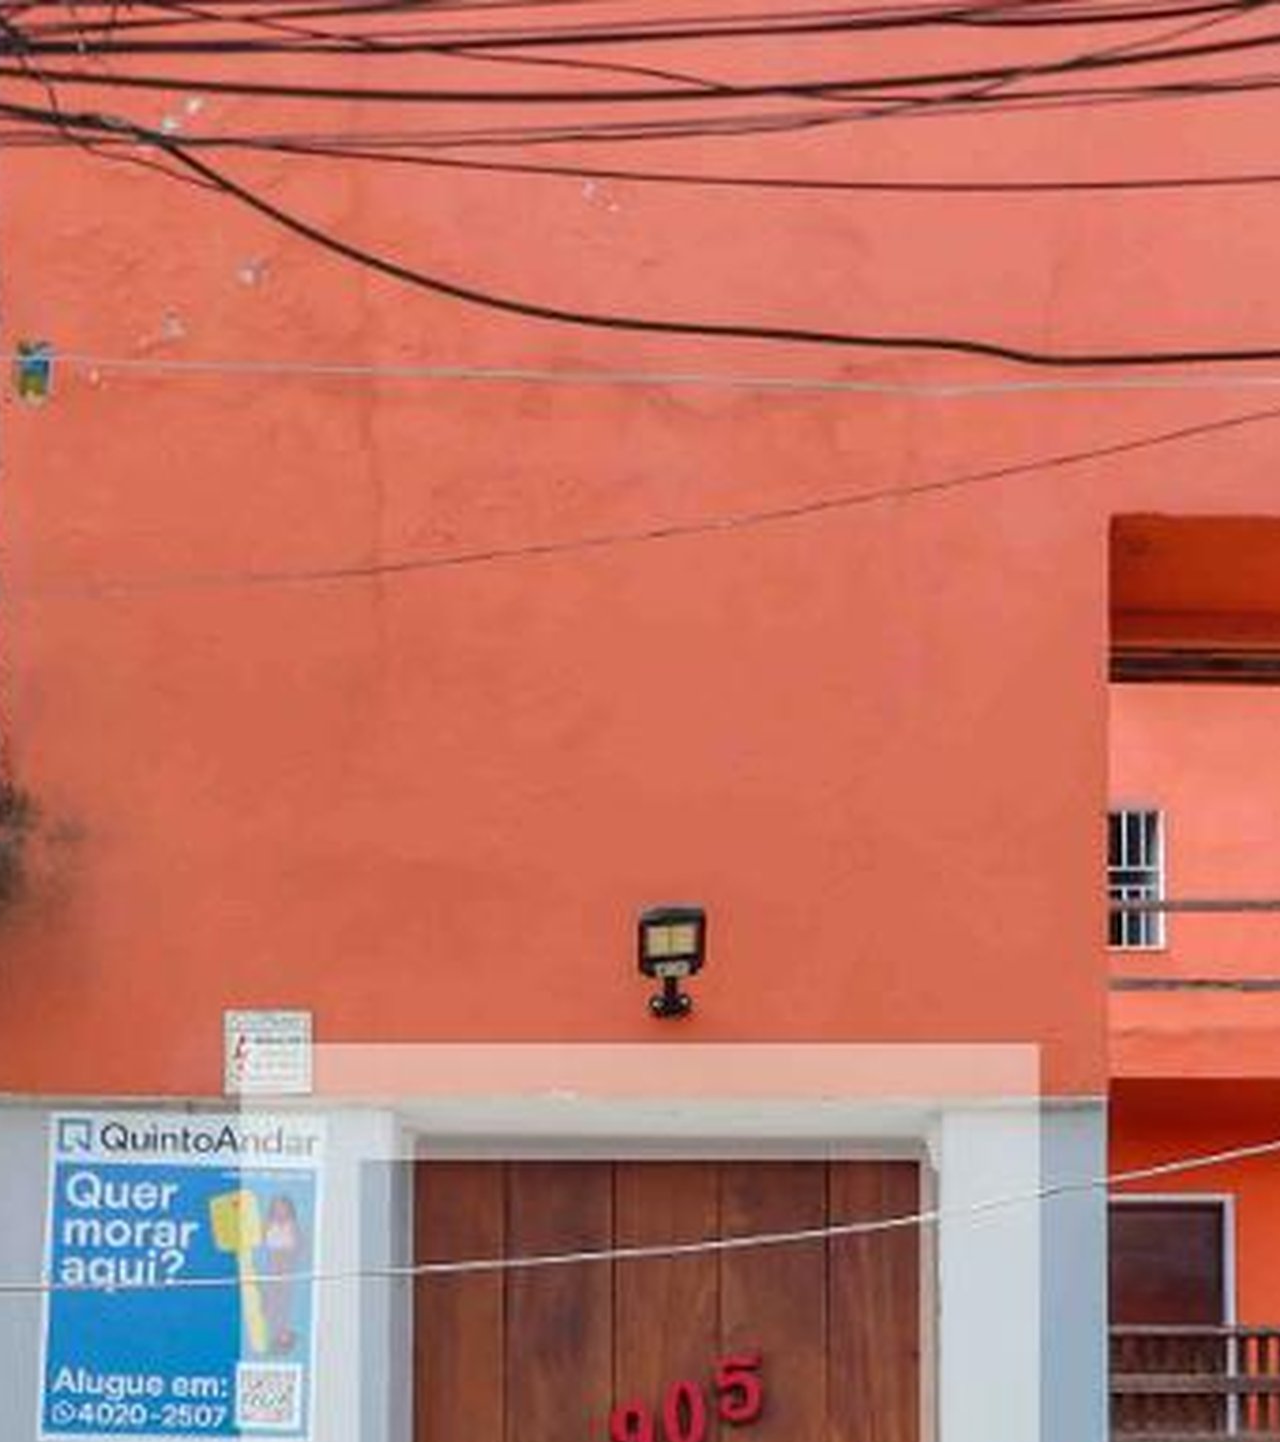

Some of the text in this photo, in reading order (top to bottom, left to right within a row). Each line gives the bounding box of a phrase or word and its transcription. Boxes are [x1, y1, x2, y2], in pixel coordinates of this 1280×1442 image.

[99, 1120, 318, 1153] QuintoAndar
[65, 1170, 179, 1211] Quer
[62, 1216, 200, 1248] morar
[60, 1251, 186, 1292] aqui?
[51, 1366, 229, 1401] Alugue em:
[76, 1401, 228, 1428] 4020-2507
